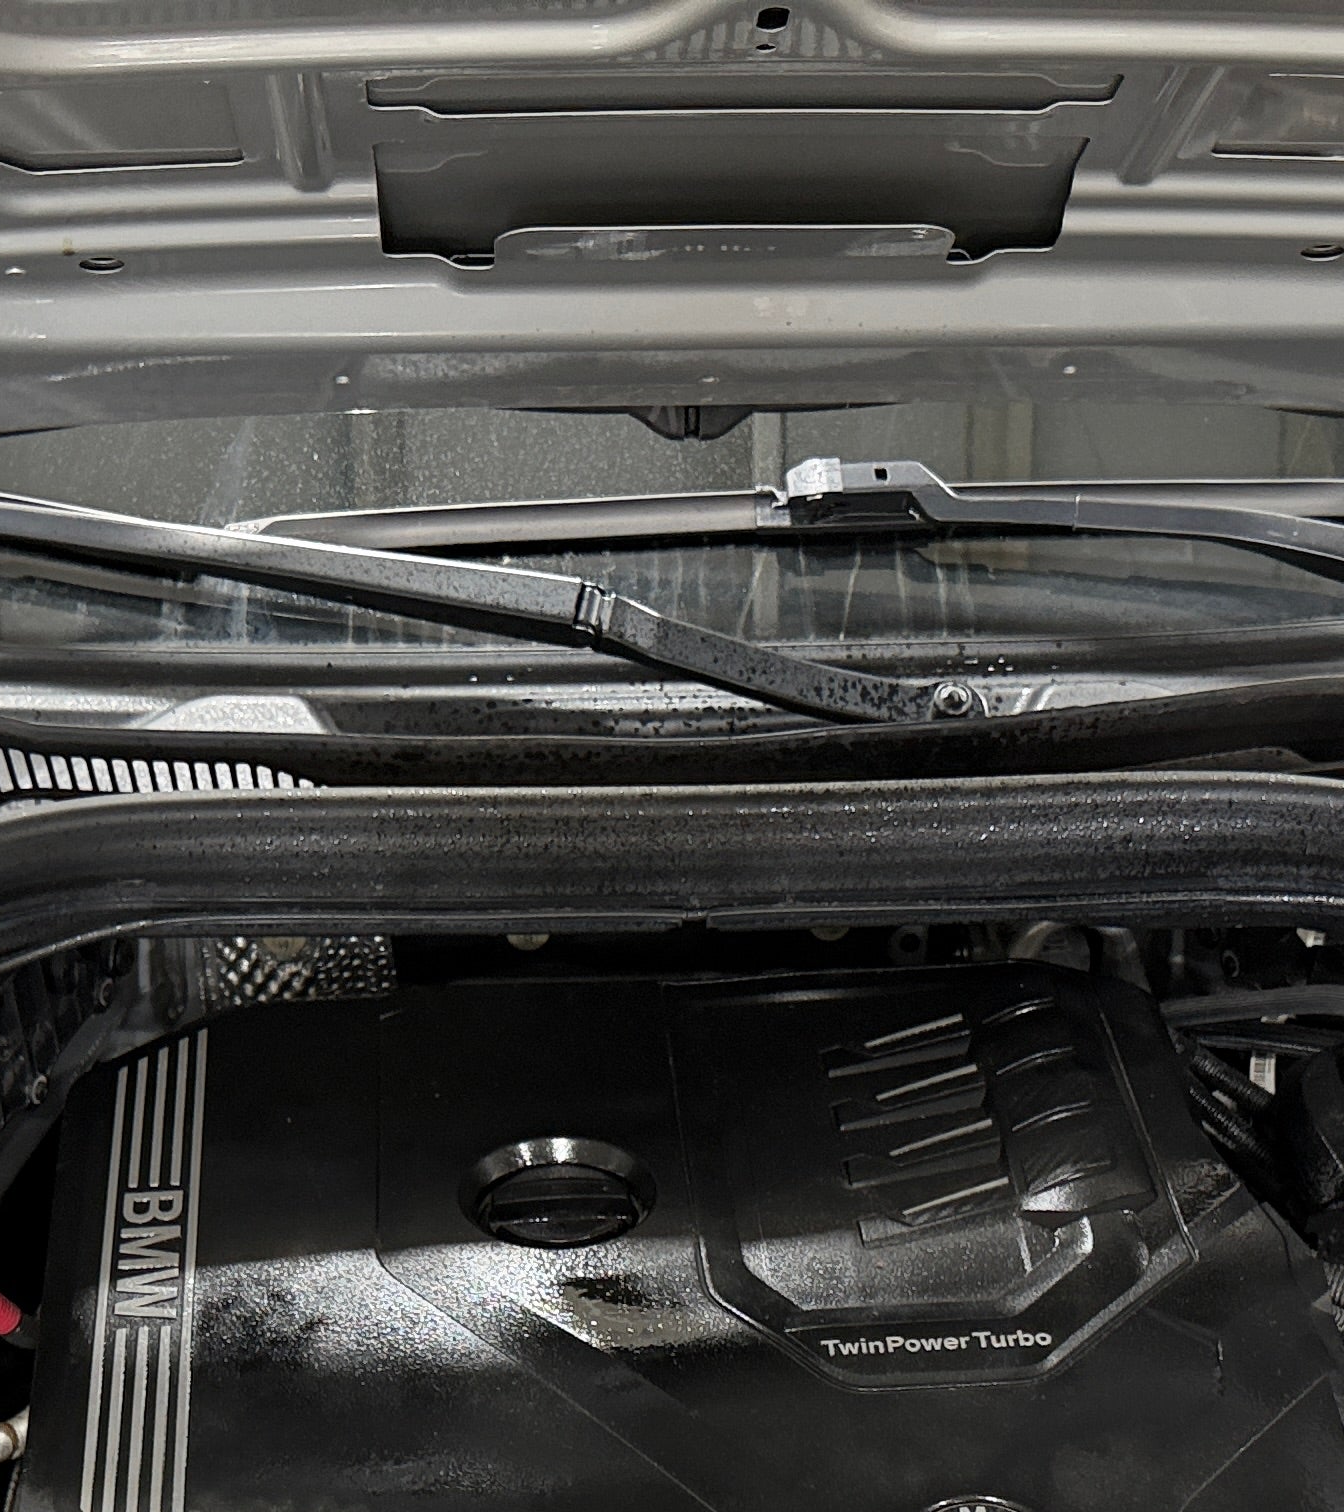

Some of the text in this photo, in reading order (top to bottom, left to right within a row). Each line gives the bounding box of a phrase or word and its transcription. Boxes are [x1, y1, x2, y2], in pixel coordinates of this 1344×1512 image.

[114, 1190, 184, 1319] BMW
[820, 1329, 1053, 1357] TwinPower Turbo
